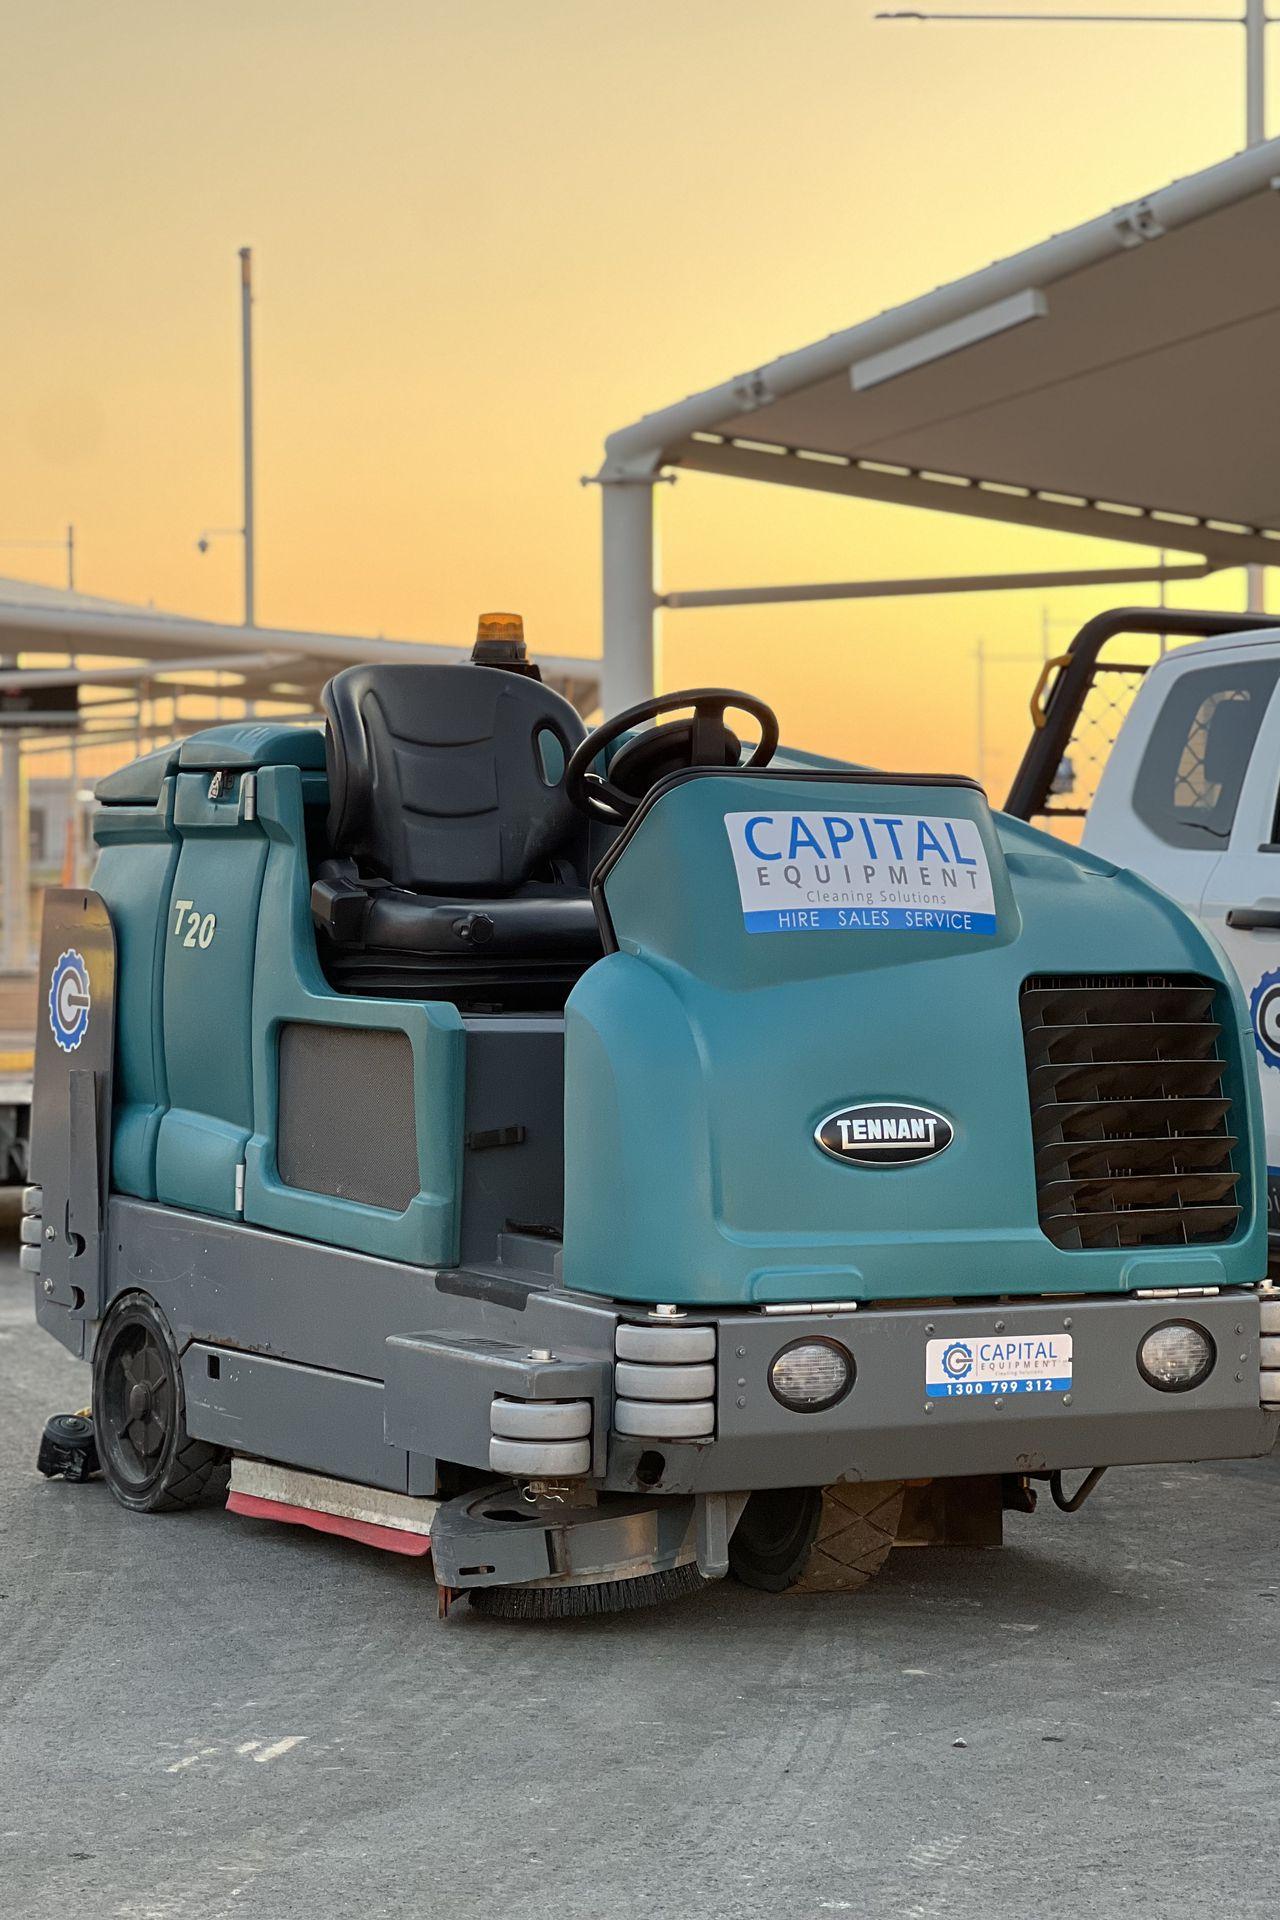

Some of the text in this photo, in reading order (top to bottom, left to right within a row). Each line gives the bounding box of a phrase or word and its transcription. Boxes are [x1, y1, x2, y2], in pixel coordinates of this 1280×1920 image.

[744, 816, 977, 866] CAPITAL
[757, 865, 978, 890] EQUIPMENT
[806, 890, 947, 905] Cleaning Solutions
[174, 900, 217, 950] T20
[778, 910, 972, 930] HIRE SALES SERVICE
[836, 1118, 938, 1150] TENNANT
[980, 1342, 1058, 1361] CAPITAL
[980, 1360, 1057, 1371] EQUIPMENT
[946, 1379, 1053, 1395] 1300 799 312
